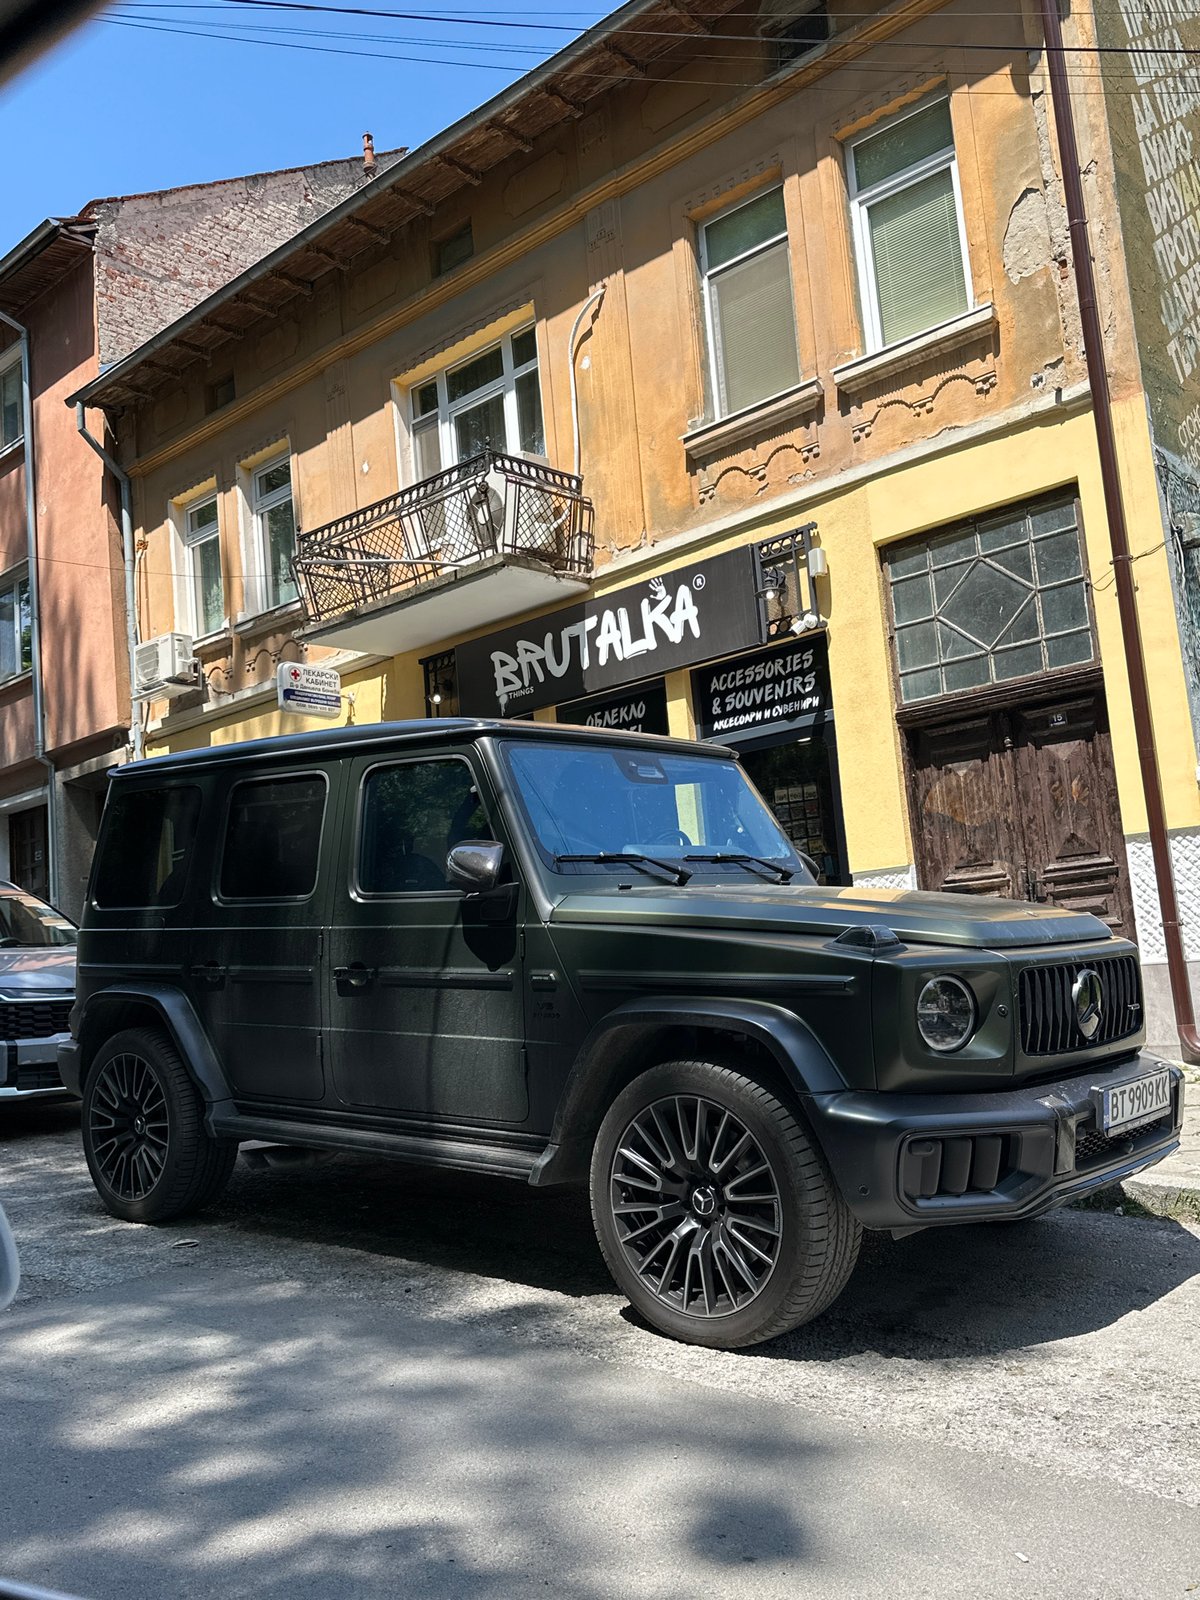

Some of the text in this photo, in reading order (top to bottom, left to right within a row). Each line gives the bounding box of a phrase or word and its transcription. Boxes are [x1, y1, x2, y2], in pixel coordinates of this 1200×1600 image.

[1126, 28, 1189, 86] ШАНСА
[1130, 88, 1160, 142] ДА
[1152, 209, 1200, 284] ПРОГР
[490, 584, 701, 698] BRUTALKA
[303, 669, 338, 680] ЛЕКАРСКИ
[305, 677, 337, 688] КАБИНЕТ
[710, 648, 814, 693] ACCESSORIES
[508, 685, 535, 700] THINGS
[711, 671, 816, 715] & SOUVENIRS
[585, 700, 646, 728] ОБЛЕКЛО
[713, 696, 820, 731] АКСЕСОАРИ И СУВЕНИРИ
[1052, 713, 1064, 722] 15
[1128, 1081, 1154, 1116] 9909
[1155, 1076, 1168, 1105] KK
